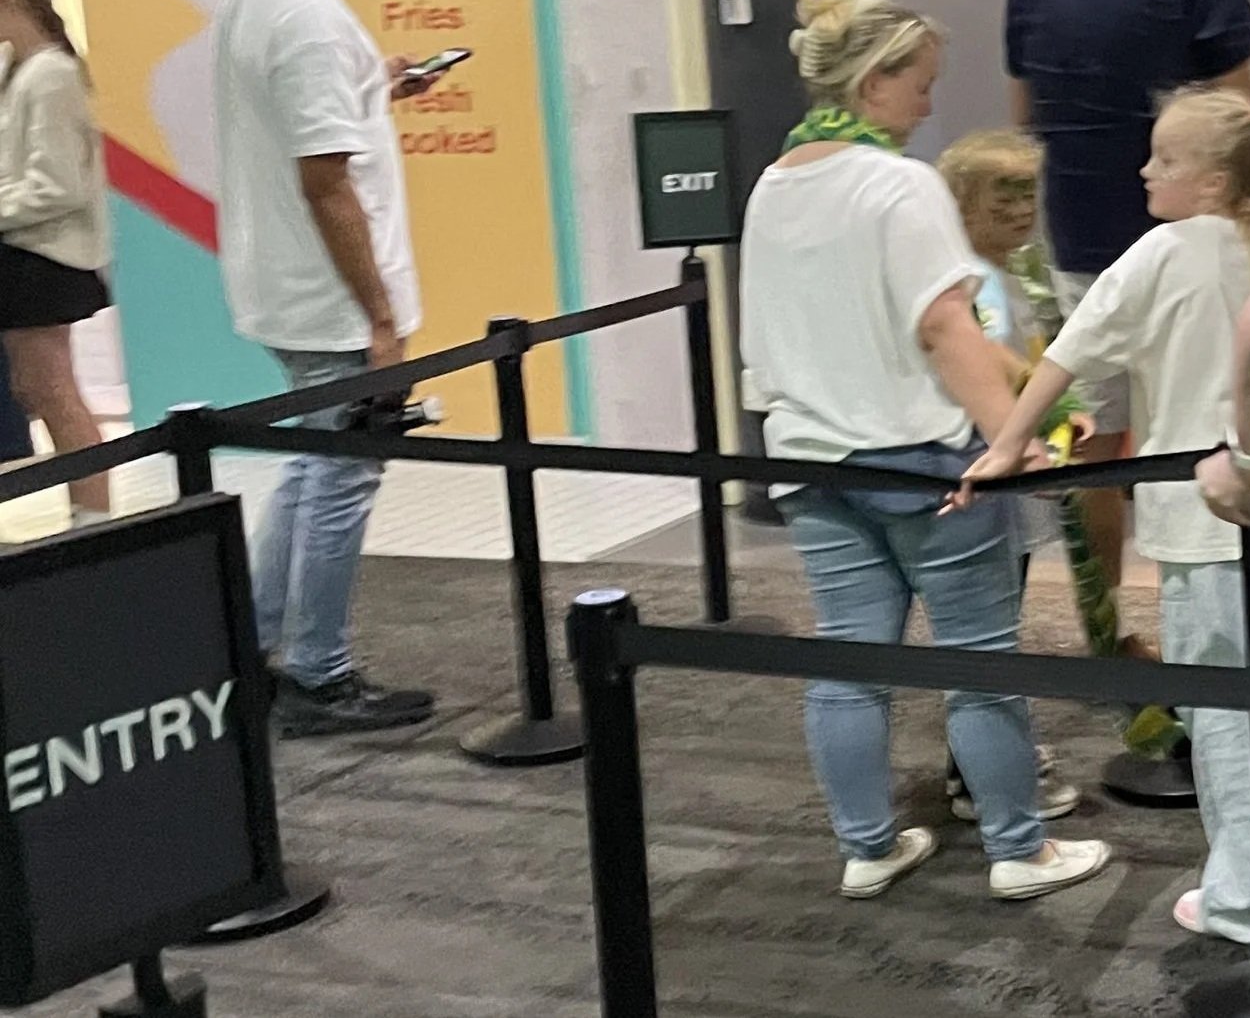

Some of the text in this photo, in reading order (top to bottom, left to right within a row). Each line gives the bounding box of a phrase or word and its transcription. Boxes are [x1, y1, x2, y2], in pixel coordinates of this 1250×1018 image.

[381, 0, 464, 31] Fries
[400, 125, 496, 154] ooked
[661, 171, 719, 193] EXIT
[4, 680, 234, 812] ENTRY
